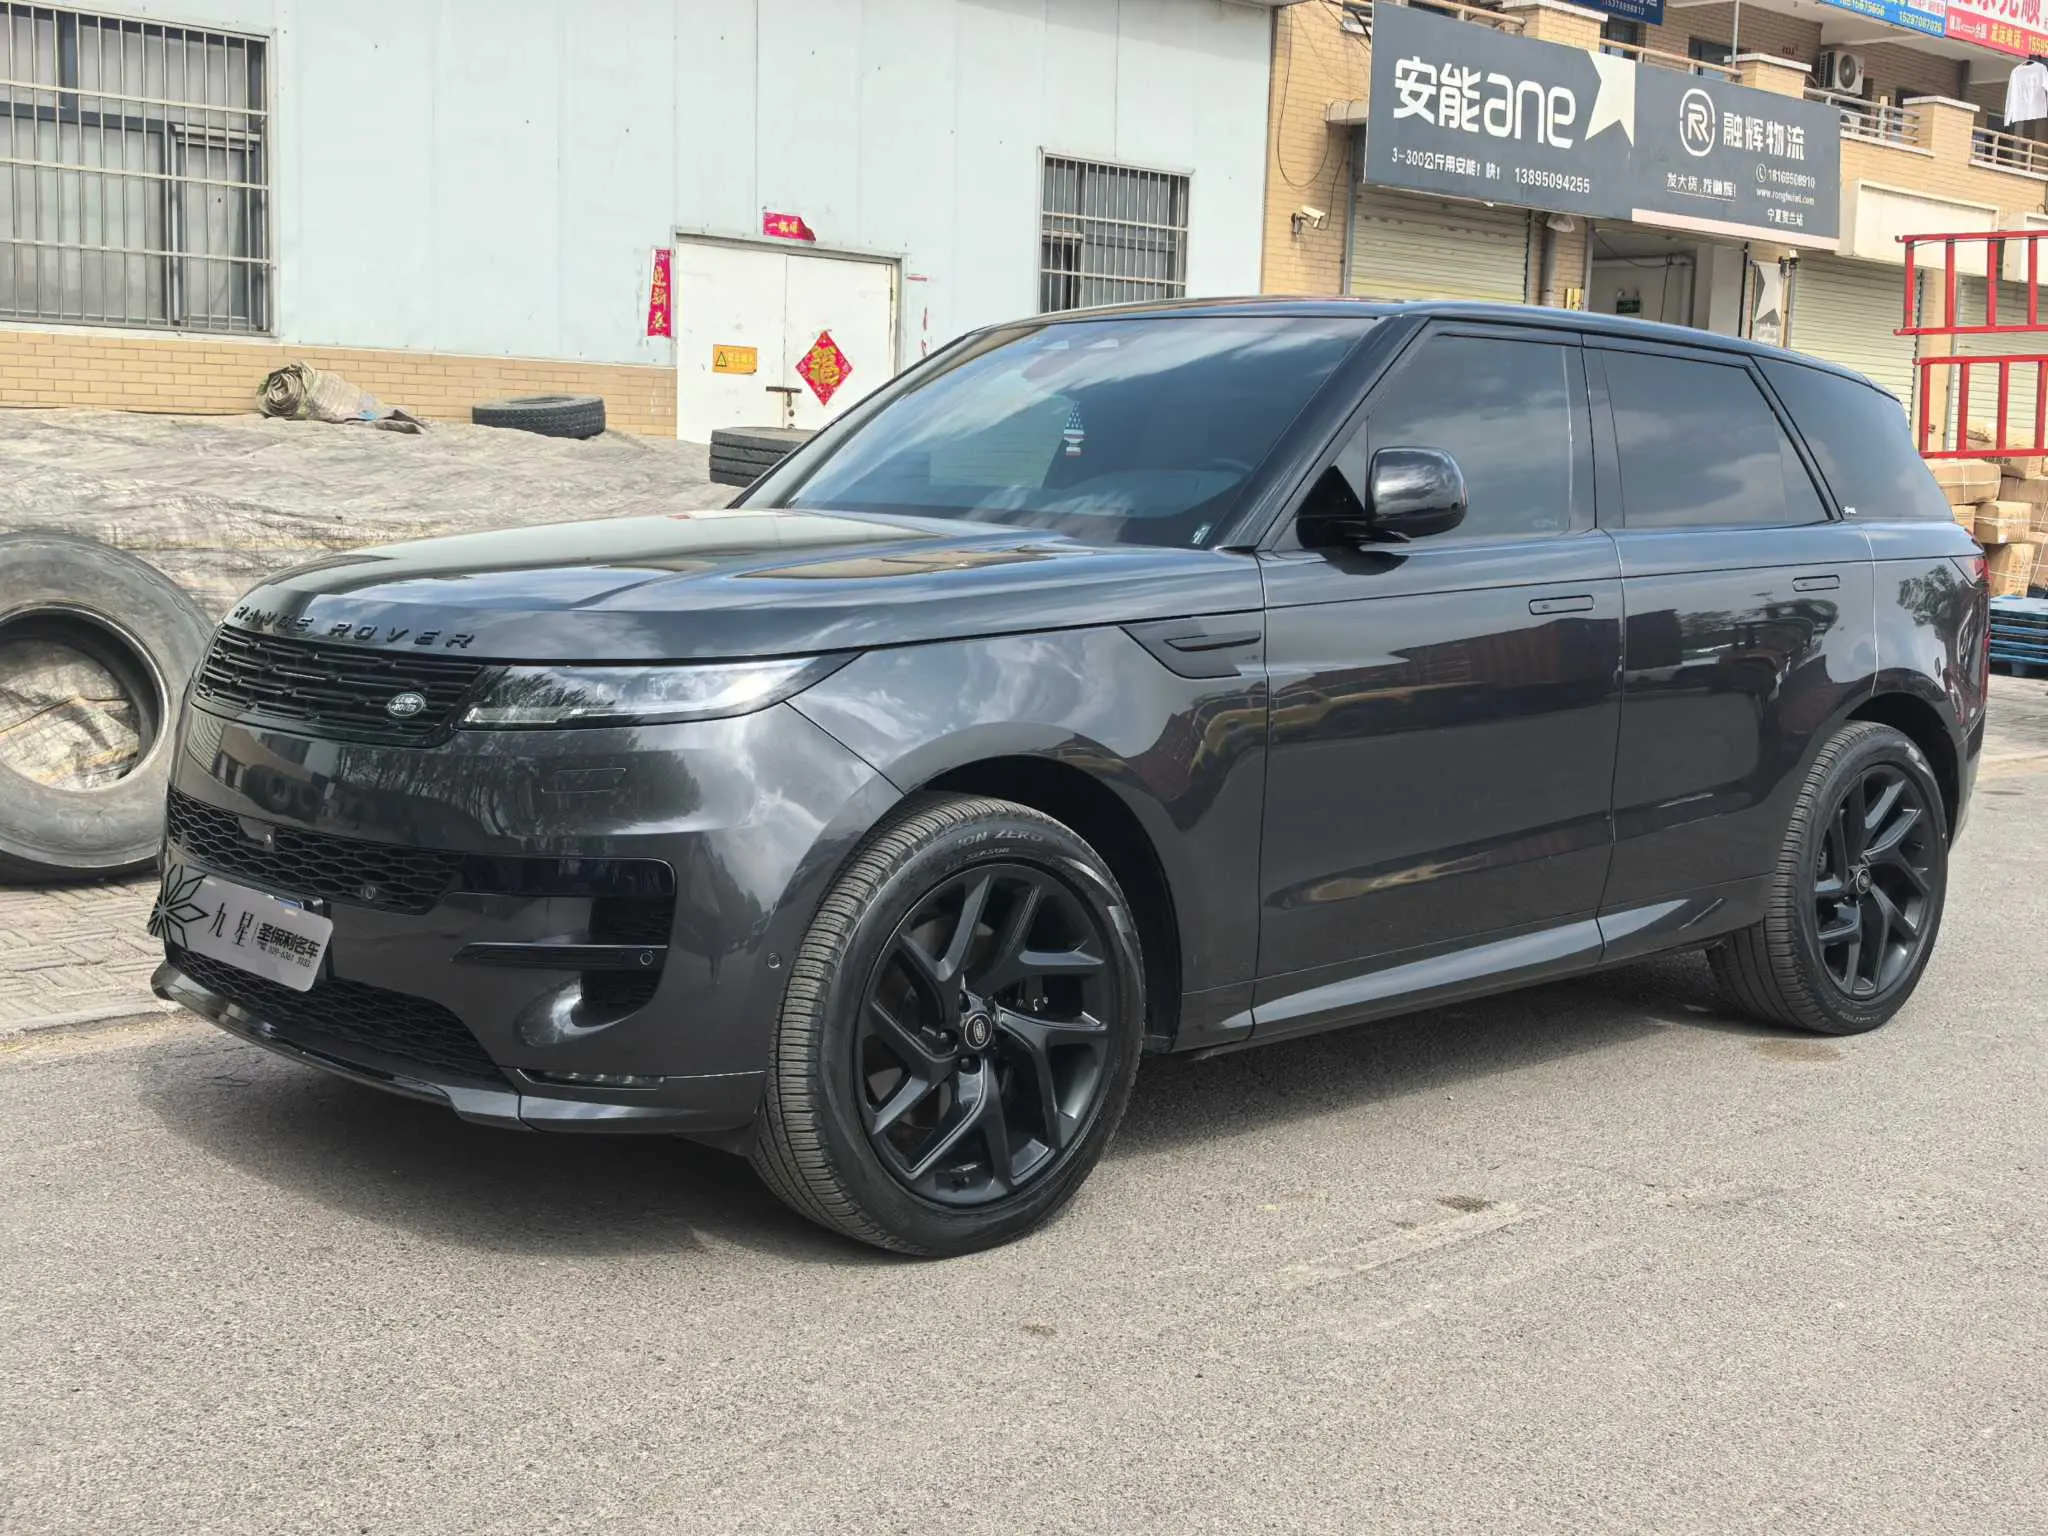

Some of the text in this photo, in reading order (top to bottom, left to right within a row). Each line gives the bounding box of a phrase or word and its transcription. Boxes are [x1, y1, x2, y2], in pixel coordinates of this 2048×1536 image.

[1723, 111, 1805, 161] 融辉物流
[1514, 167, 1591, 194] 13895094255
[234, 606, 476, 649] RANGE ROVER
